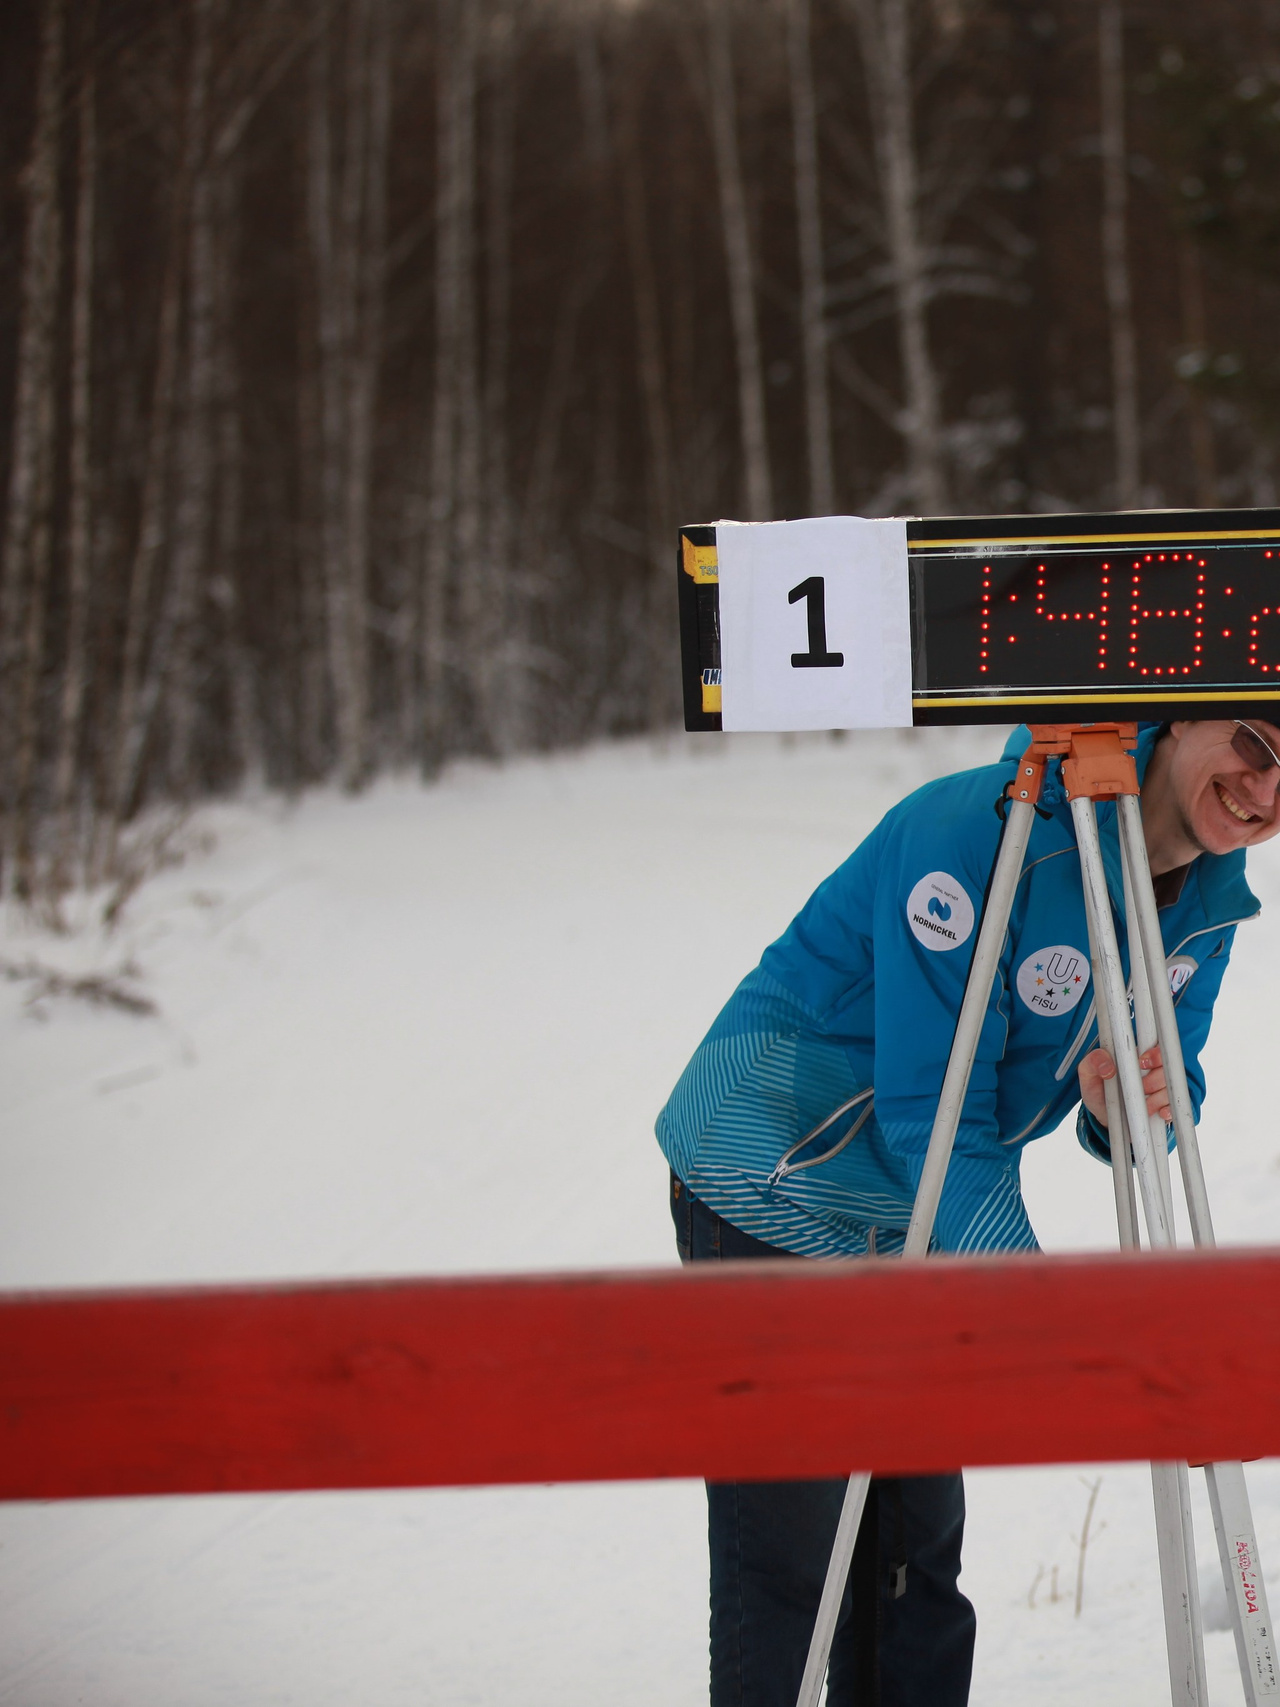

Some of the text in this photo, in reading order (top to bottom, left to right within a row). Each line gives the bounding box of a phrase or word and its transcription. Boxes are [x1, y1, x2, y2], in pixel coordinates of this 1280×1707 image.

[787, 576, 845, 668] 1
[913, 913, 957, 941] NORNICKEL
[1031, 995, 1058, 1011] FISU
